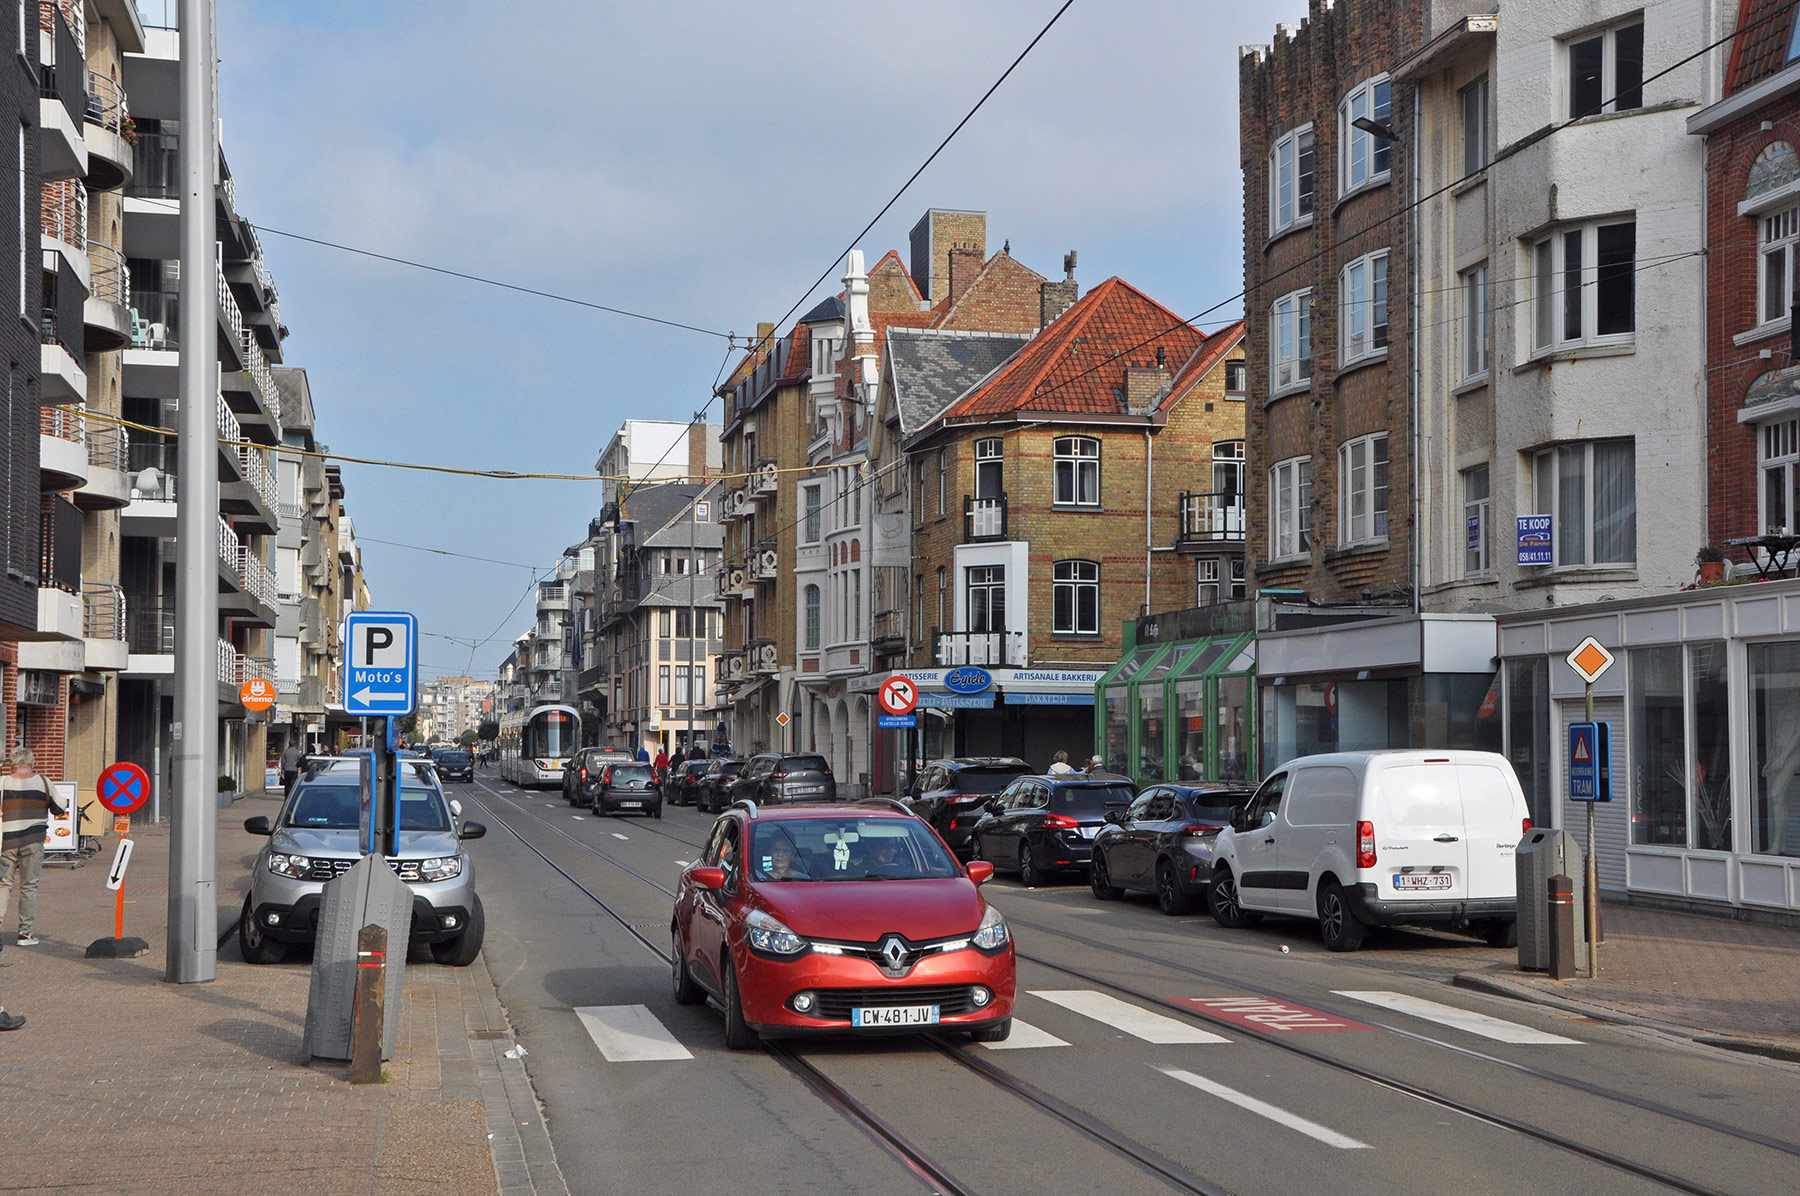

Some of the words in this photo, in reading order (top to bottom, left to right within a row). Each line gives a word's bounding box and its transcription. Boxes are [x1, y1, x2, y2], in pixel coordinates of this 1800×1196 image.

[1518, 519, 1528, 530] TE
[1529, 518, 1550, 530] KOOP
[366, 627, 393, 665] P
[1013, 672, 1059, 681] ARTISANALE
[1061, 673, 1097, 682] BAKKERIJ
[1025, 695, 1068, 704] BAKKERIJ
[1571, 767, 1593, 776] VOORRANG
[1572, 780, 1592, 794] TRAM
[863, 1008, 929, 1024] CW-481-JV
[1189, 998, 1346, 1030] TRAM
